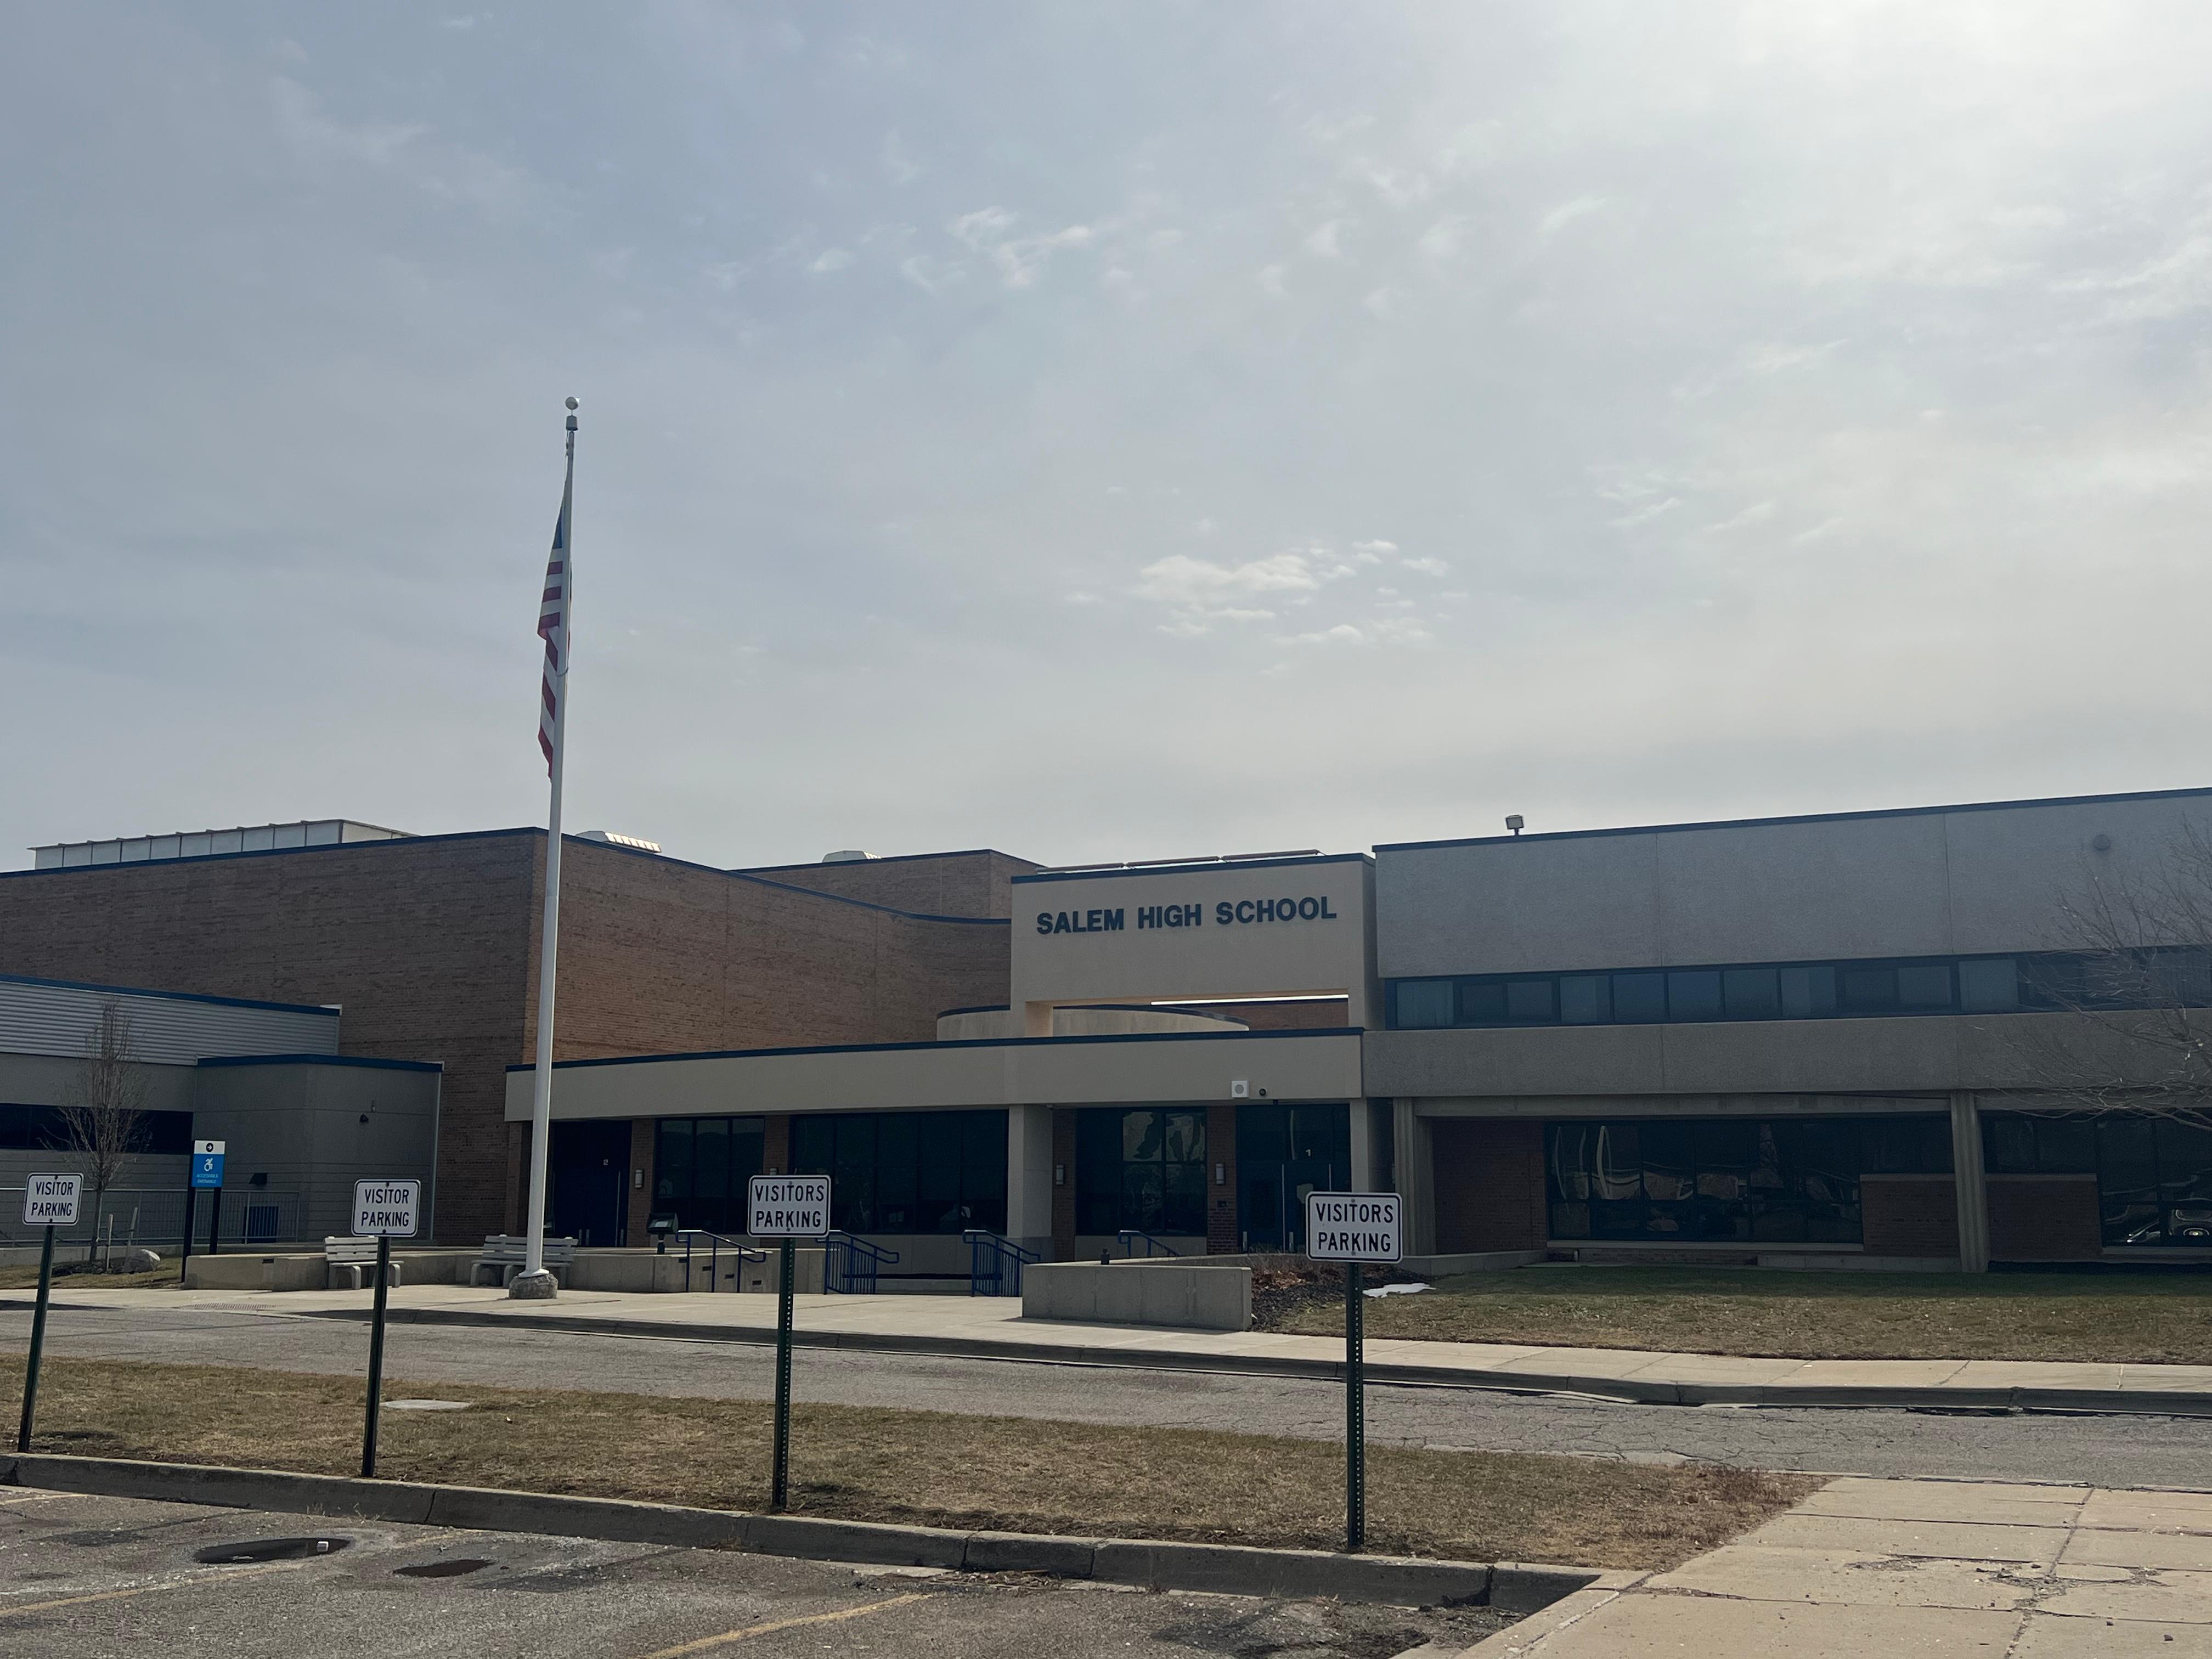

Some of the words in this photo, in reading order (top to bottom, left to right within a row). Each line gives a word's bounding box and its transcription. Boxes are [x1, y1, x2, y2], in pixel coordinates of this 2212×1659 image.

[1036, 909, 1125, 934] SALEM
[1138, 904, 1201, 929] HIGH
[1216, 896, 1337, 924] SCHOOL
[36, 1181, 74, 1195] VISITOR
[364, 1189, 409, 1204] VISITOR
[755, 1184, 825, 1201] VISITORS
[31, 1202, 72, 1216] PARKING
[1316, 1203, 1393, 1223] VISITORS
[361, 1211, 409, 1227] PARKING
[756, 1211, 821, 1228] PARKING
[1318, 1232, 1391, 1252] PARKING
